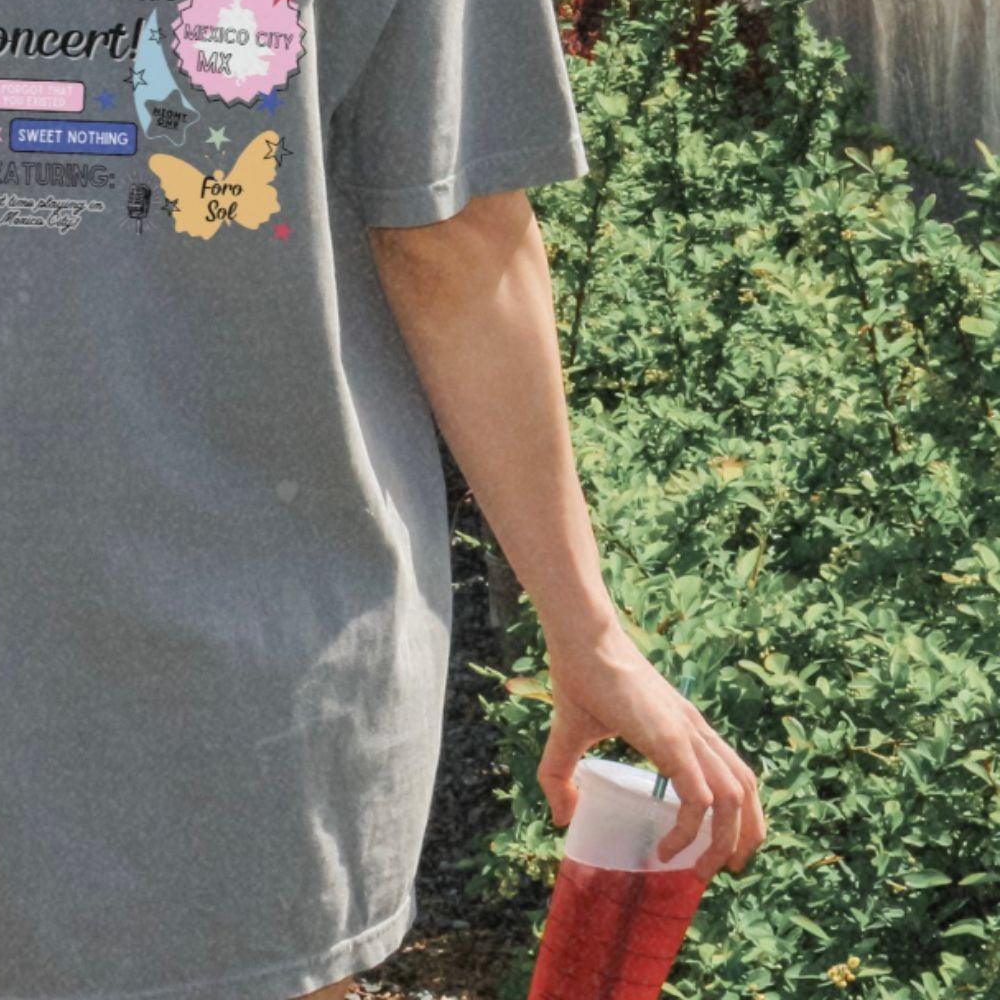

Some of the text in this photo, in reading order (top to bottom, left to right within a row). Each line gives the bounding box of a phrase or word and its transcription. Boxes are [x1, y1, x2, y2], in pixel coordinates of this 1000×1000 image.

[183, 23, 294, 51] MEXICO CITY
[196, 50, 233, 75] MX
[18, 129, 129, 146] SWEET NOTHING
[200, 176, 243, 199] Foro
[205, 200, 239, 222] Sol
